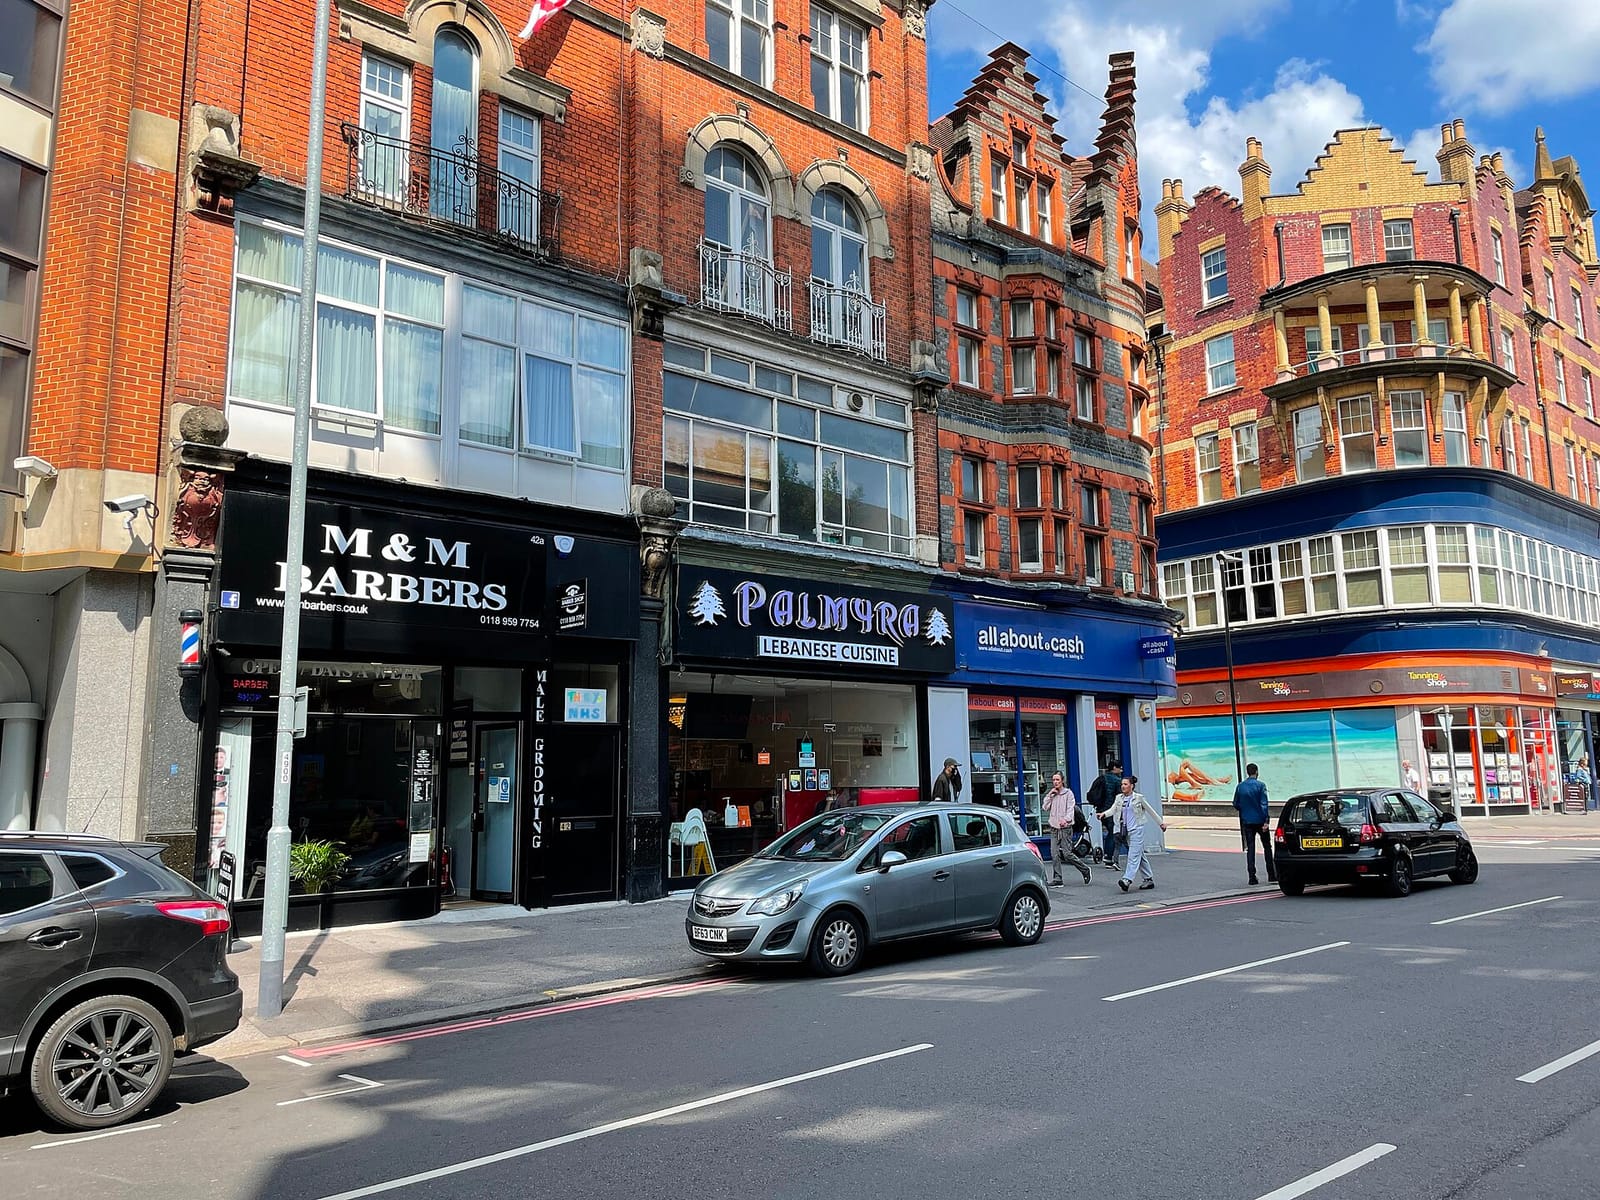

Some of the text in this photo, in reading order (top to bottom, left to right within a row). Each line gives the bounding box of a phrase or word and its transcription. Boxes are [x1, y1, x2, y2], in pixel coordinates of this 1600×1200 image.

[320, 524, 471, 568] M & M
[530, 536, 545, 545] 42a
[274, 561, 508, 611] BARBERS
[732, 580, 920, 648] PALMYRA
[480, 615, 539, 628] 0118 959 7754
[978, 626, 997, 646] all
[1150, 639, 1168, 648] about
[762, 638, 896, 663] LEBANESE CUISINE
[241, 660, 281, 675] OPE
[1407, 671, 1438, 681] Tanning
[233, 679, 269, 690] BARBER
[1258, 681, 1284, 690] Tanning
[1426, 678, 1447, 688] Shop
[1560, 678, 1584, 686] Tanning
[1573, 682, 1589, 690] Shop
[1273, 687, 1291, 696] Shop
[997, 699, 1014, 709] cash
[1050, 701, 1066, 711] cash
[568, 708, 601, 719] NHS
[532, 670, 548, 848] MALE GROOMING
[709, 929, 724, 940] CNK
